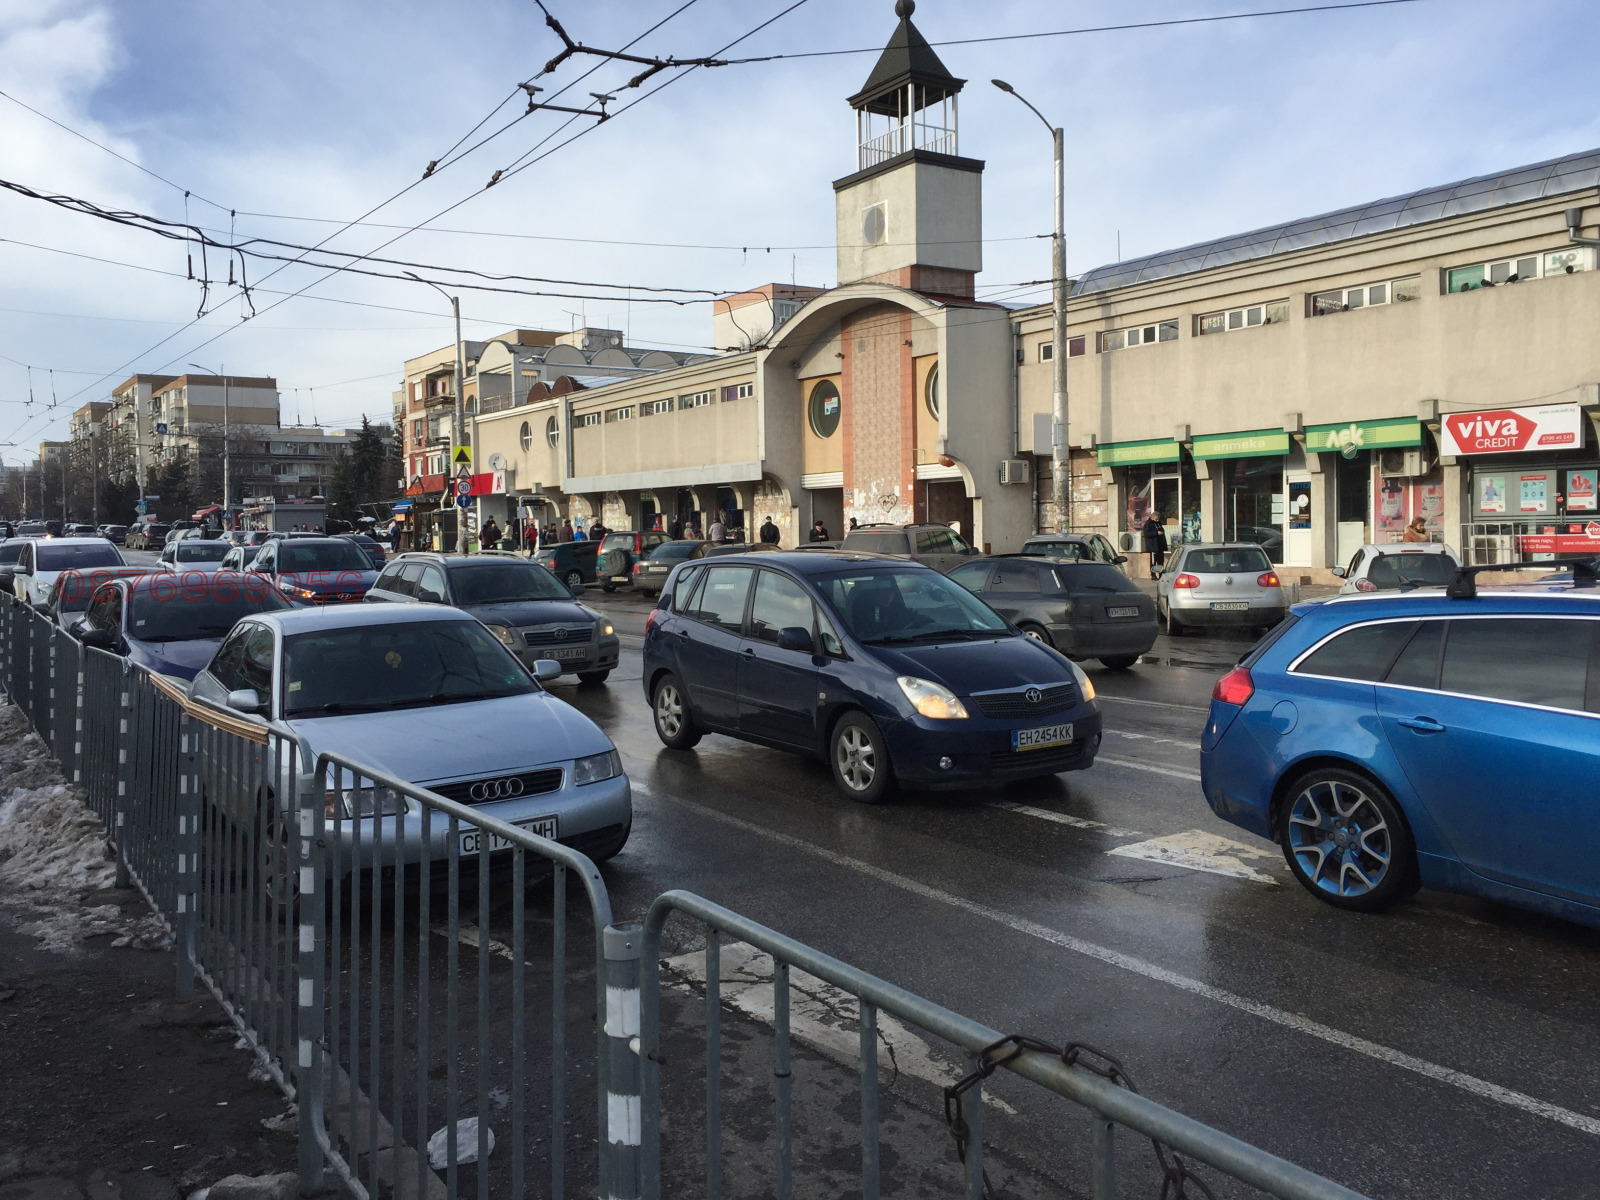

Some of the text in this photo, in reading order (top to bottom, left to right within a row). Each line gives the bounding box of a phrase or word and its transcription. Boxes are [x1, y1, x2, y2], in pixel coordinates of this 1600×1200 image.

[1202, 316, 1225, 330] DIESEL
[1458, 415, 1519, 438] viva
[1475, 436, 1518, 449] CREDIT
[1111, 447, 1163, 460] pharmacy
[460, 484, 469, 492] 30
[1571, 473, 1593, 490] 0%
[1020, 732, 1033, 745] EH
[1034, 727, 1058, 743] 2454
[1060, 725, 1072, 739] KK
